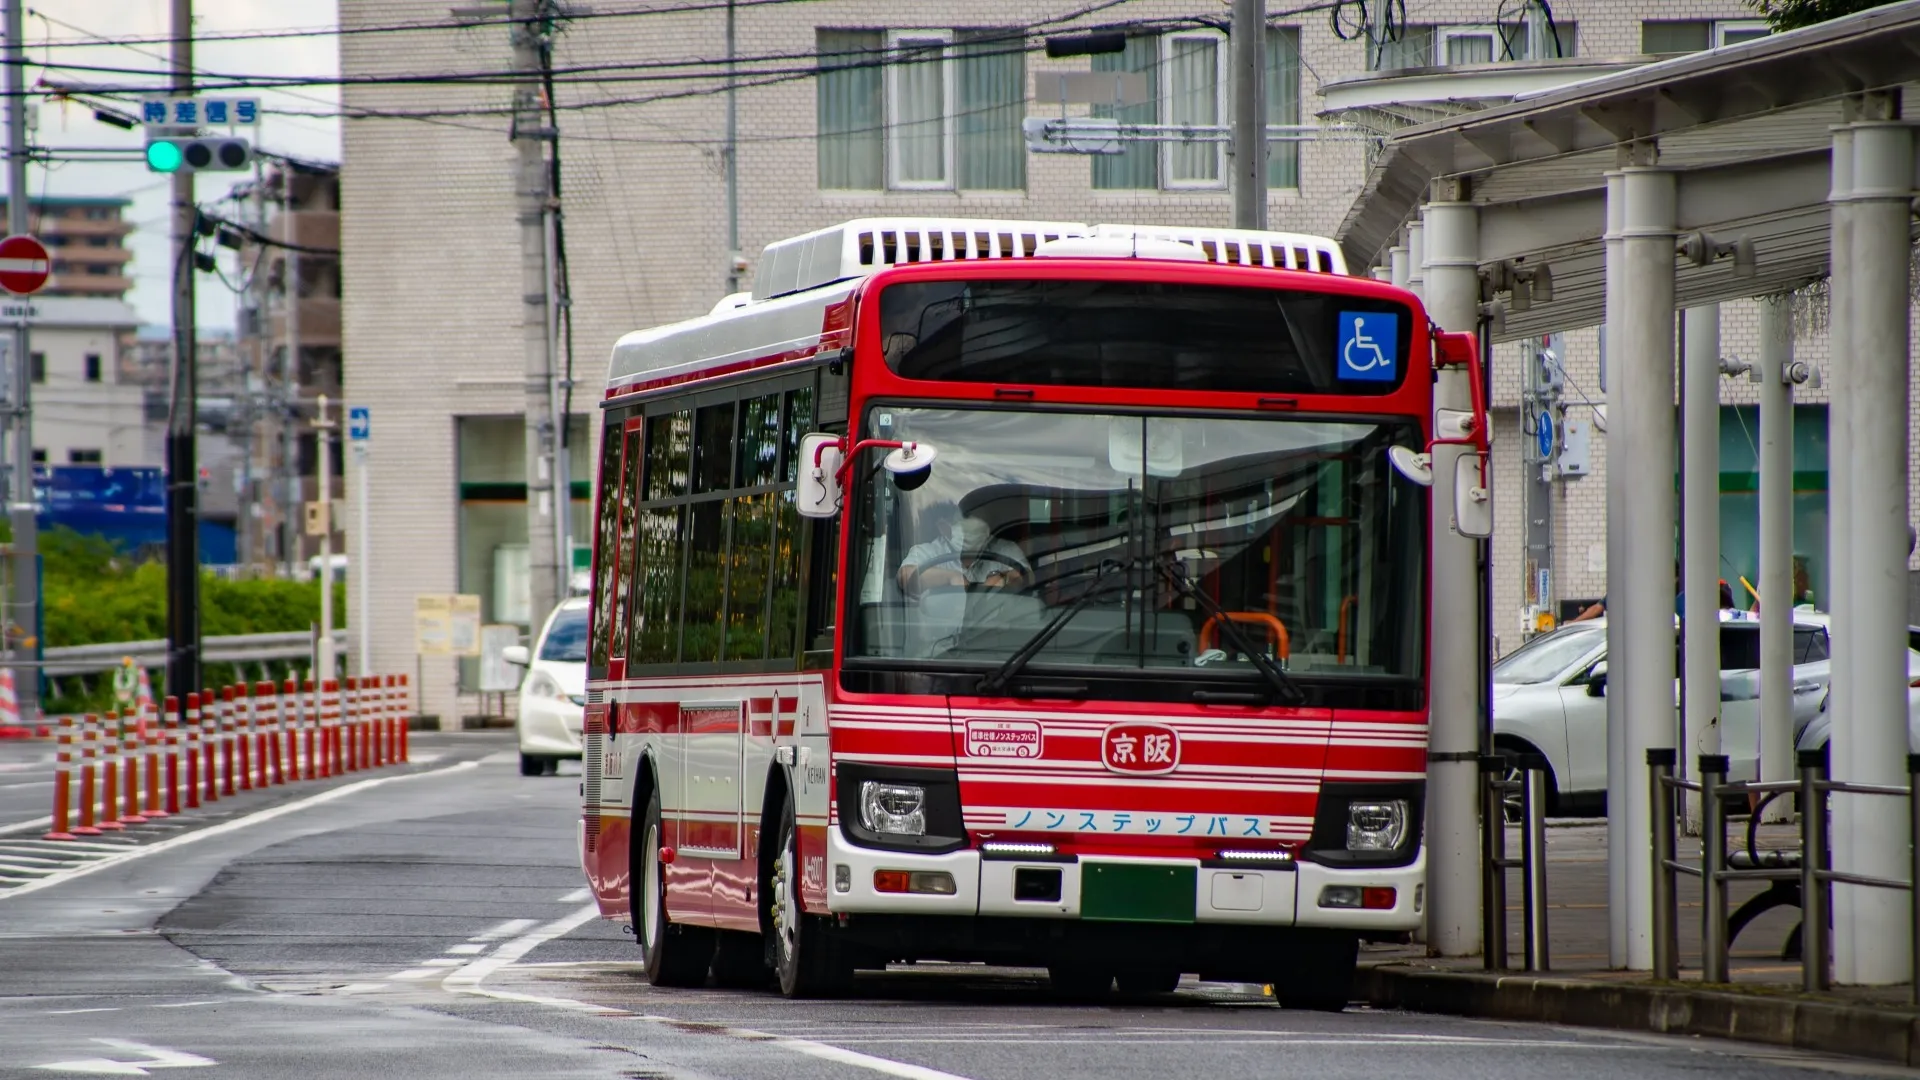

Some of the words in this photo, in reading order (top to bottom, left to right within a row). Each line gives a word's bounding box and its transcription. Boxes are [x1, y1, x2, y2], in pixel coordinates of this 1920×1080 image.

[143, 100, 257, 124] 時差信号
[1110, 732, 1172, 763] 京阪
[807, 767, 826, 784] KEIHAN
[1014, 810, 1262, 836] ノンステップバス
